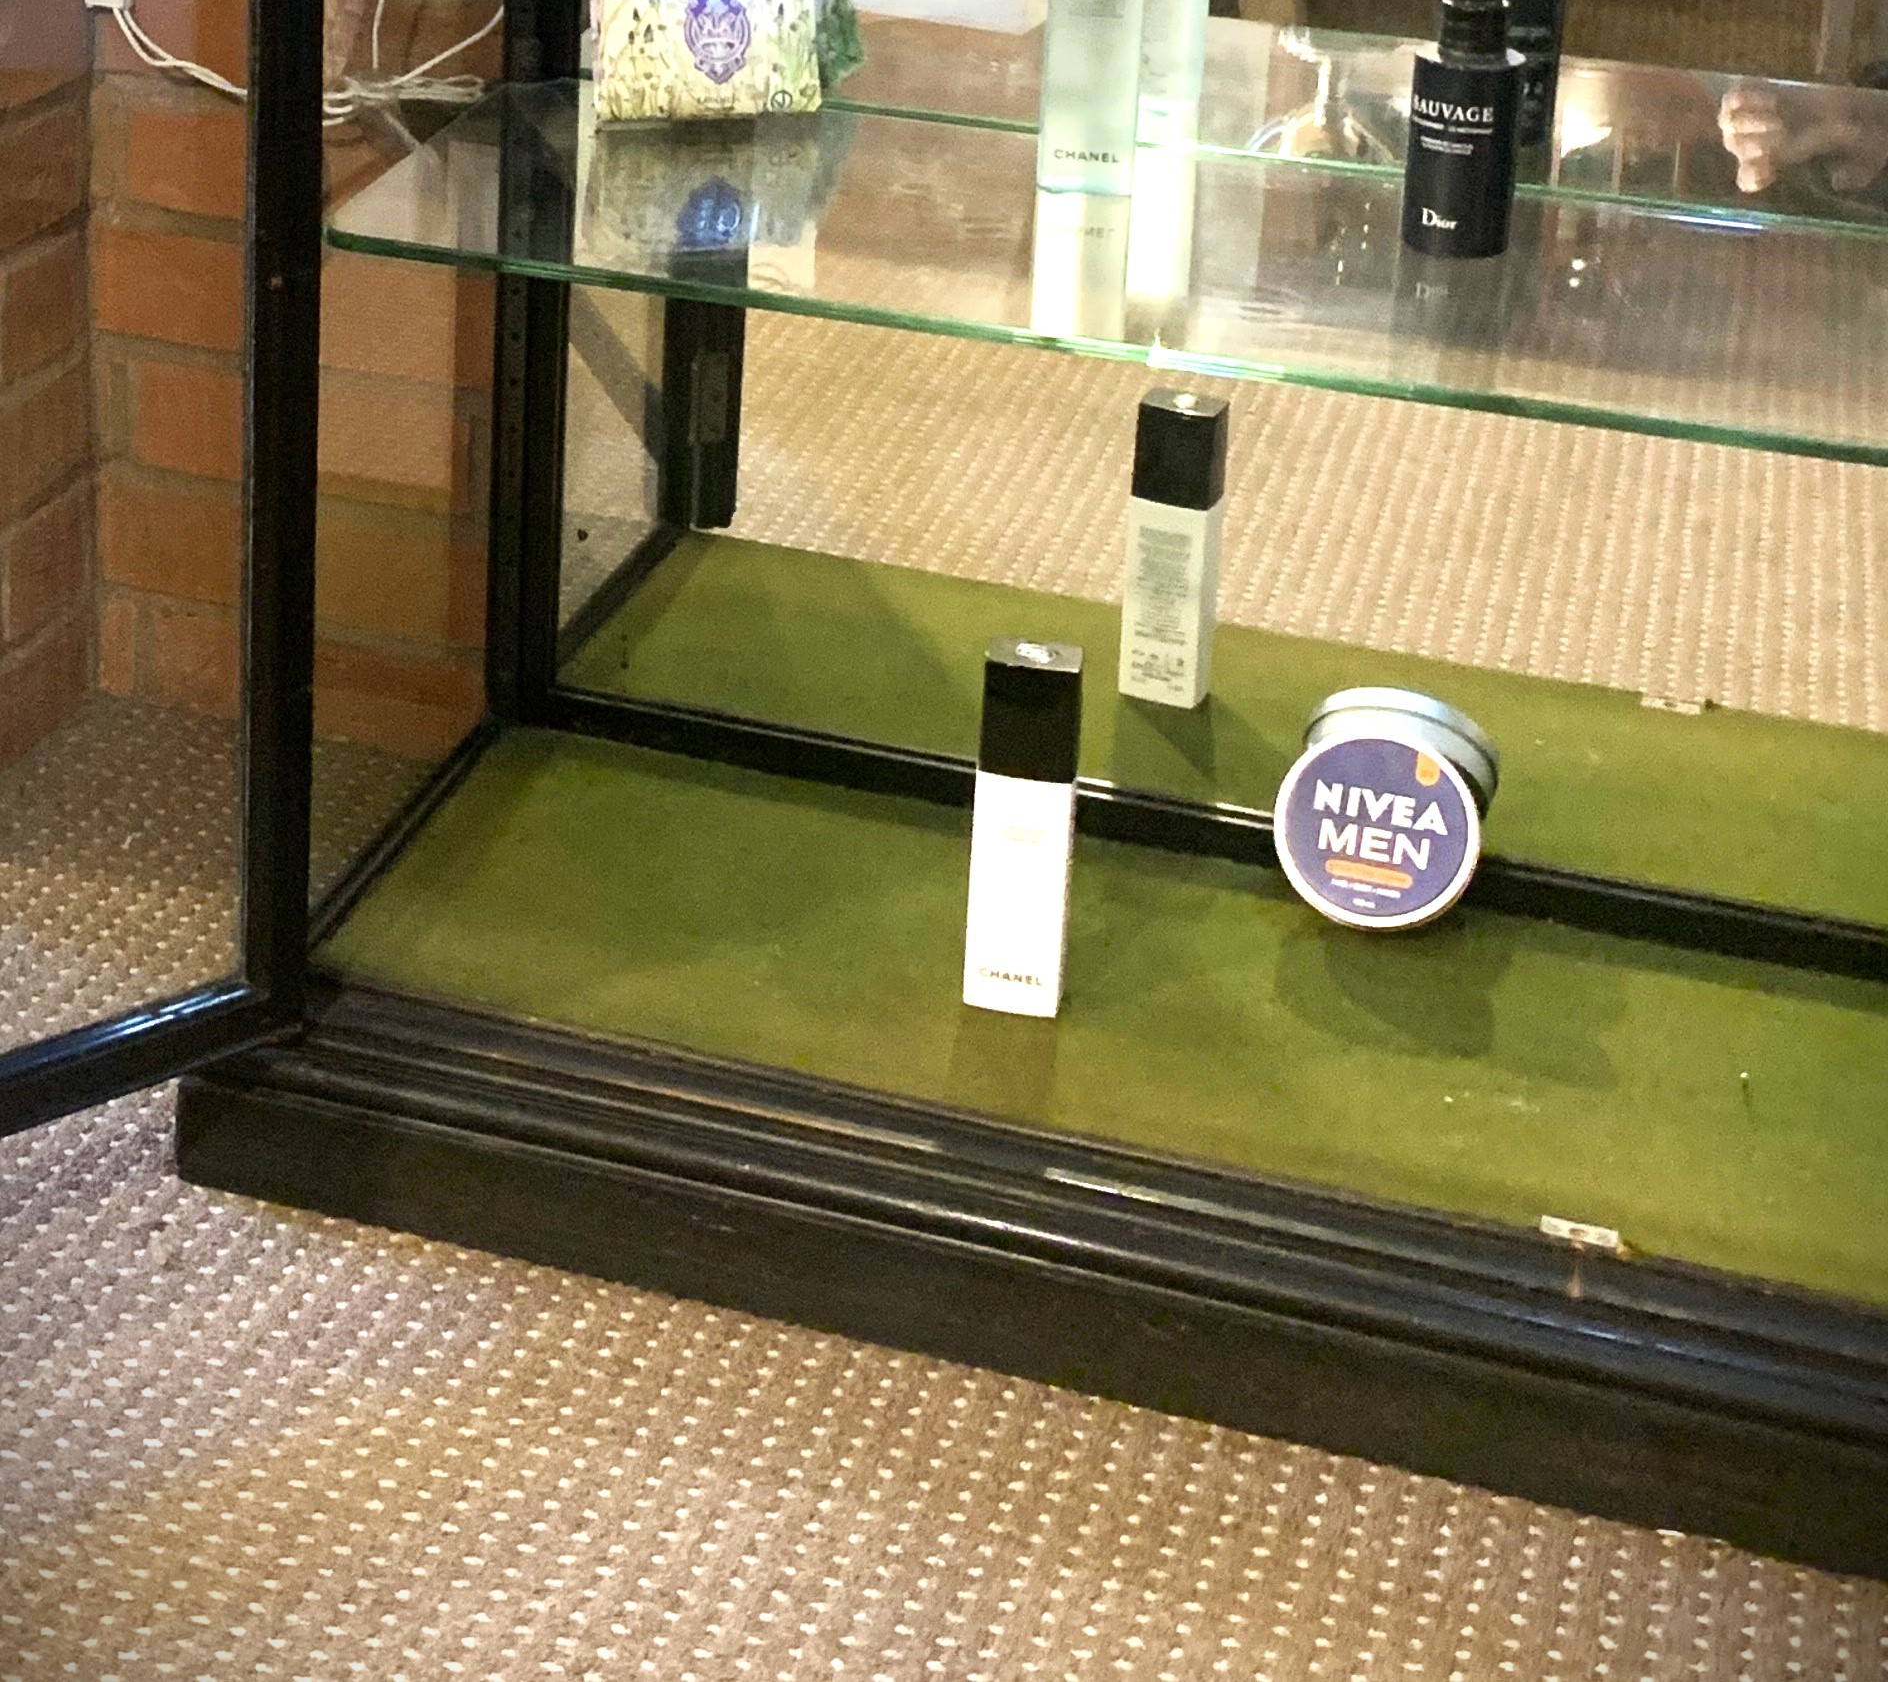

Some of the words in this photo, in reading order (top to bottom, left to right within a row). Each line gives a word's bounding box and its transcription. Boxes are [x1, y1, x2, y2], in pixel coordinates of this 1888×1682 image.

[1053, 148, 1120, 164] CHANEL
[1421, 207, 1458, 230] Dior
[1313, 778, 1448, 836] NIVEA
[1317, 818, 1431, 871] MEN
[978, 967, 1043, 986] CHANEL
